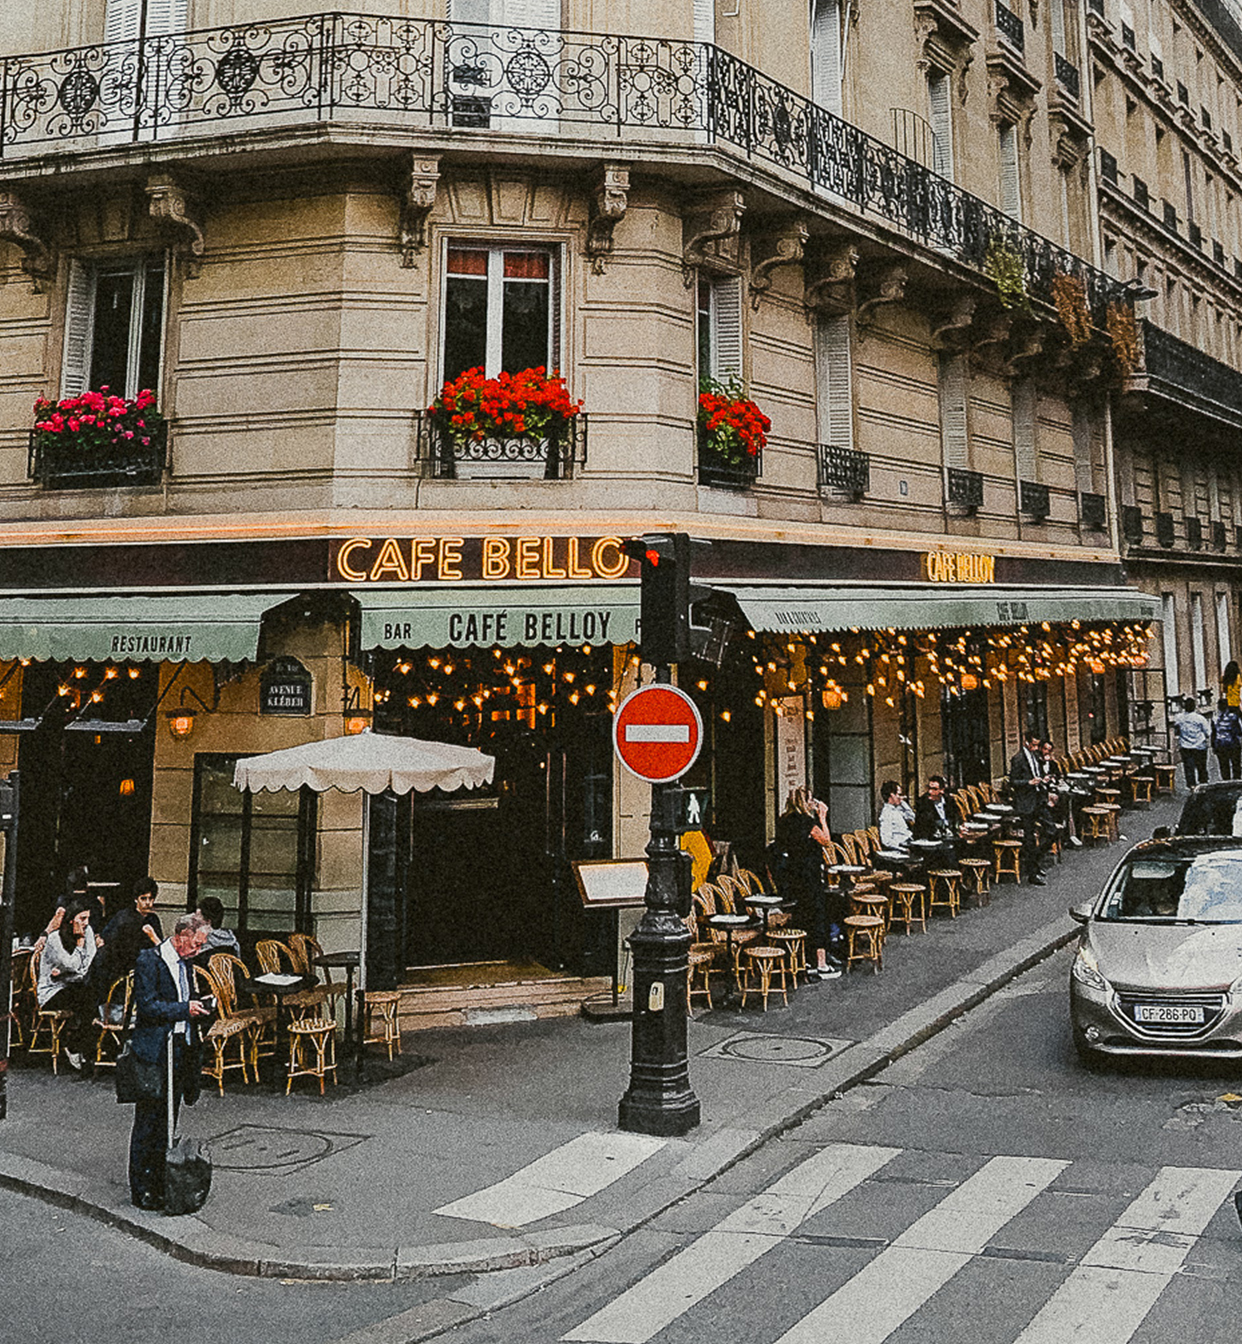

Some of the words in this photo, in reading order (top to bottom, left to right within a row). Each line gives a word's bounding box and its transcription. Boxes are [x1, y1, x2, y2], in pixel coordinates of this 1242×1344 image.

[337, 537, 464, 581] CAFE
[482, 536, 630, 580] BELLO
[957, 552, 995, 584] BELLOY
[384, 622, 412, 640] BAR
[449, 609, 508, 642] CAFÉ
[524, 611, 611, 641] BELLOY
[111, 636, 192, 652] RESTAURANT
[269, 685, 302, 694] AVENUE
